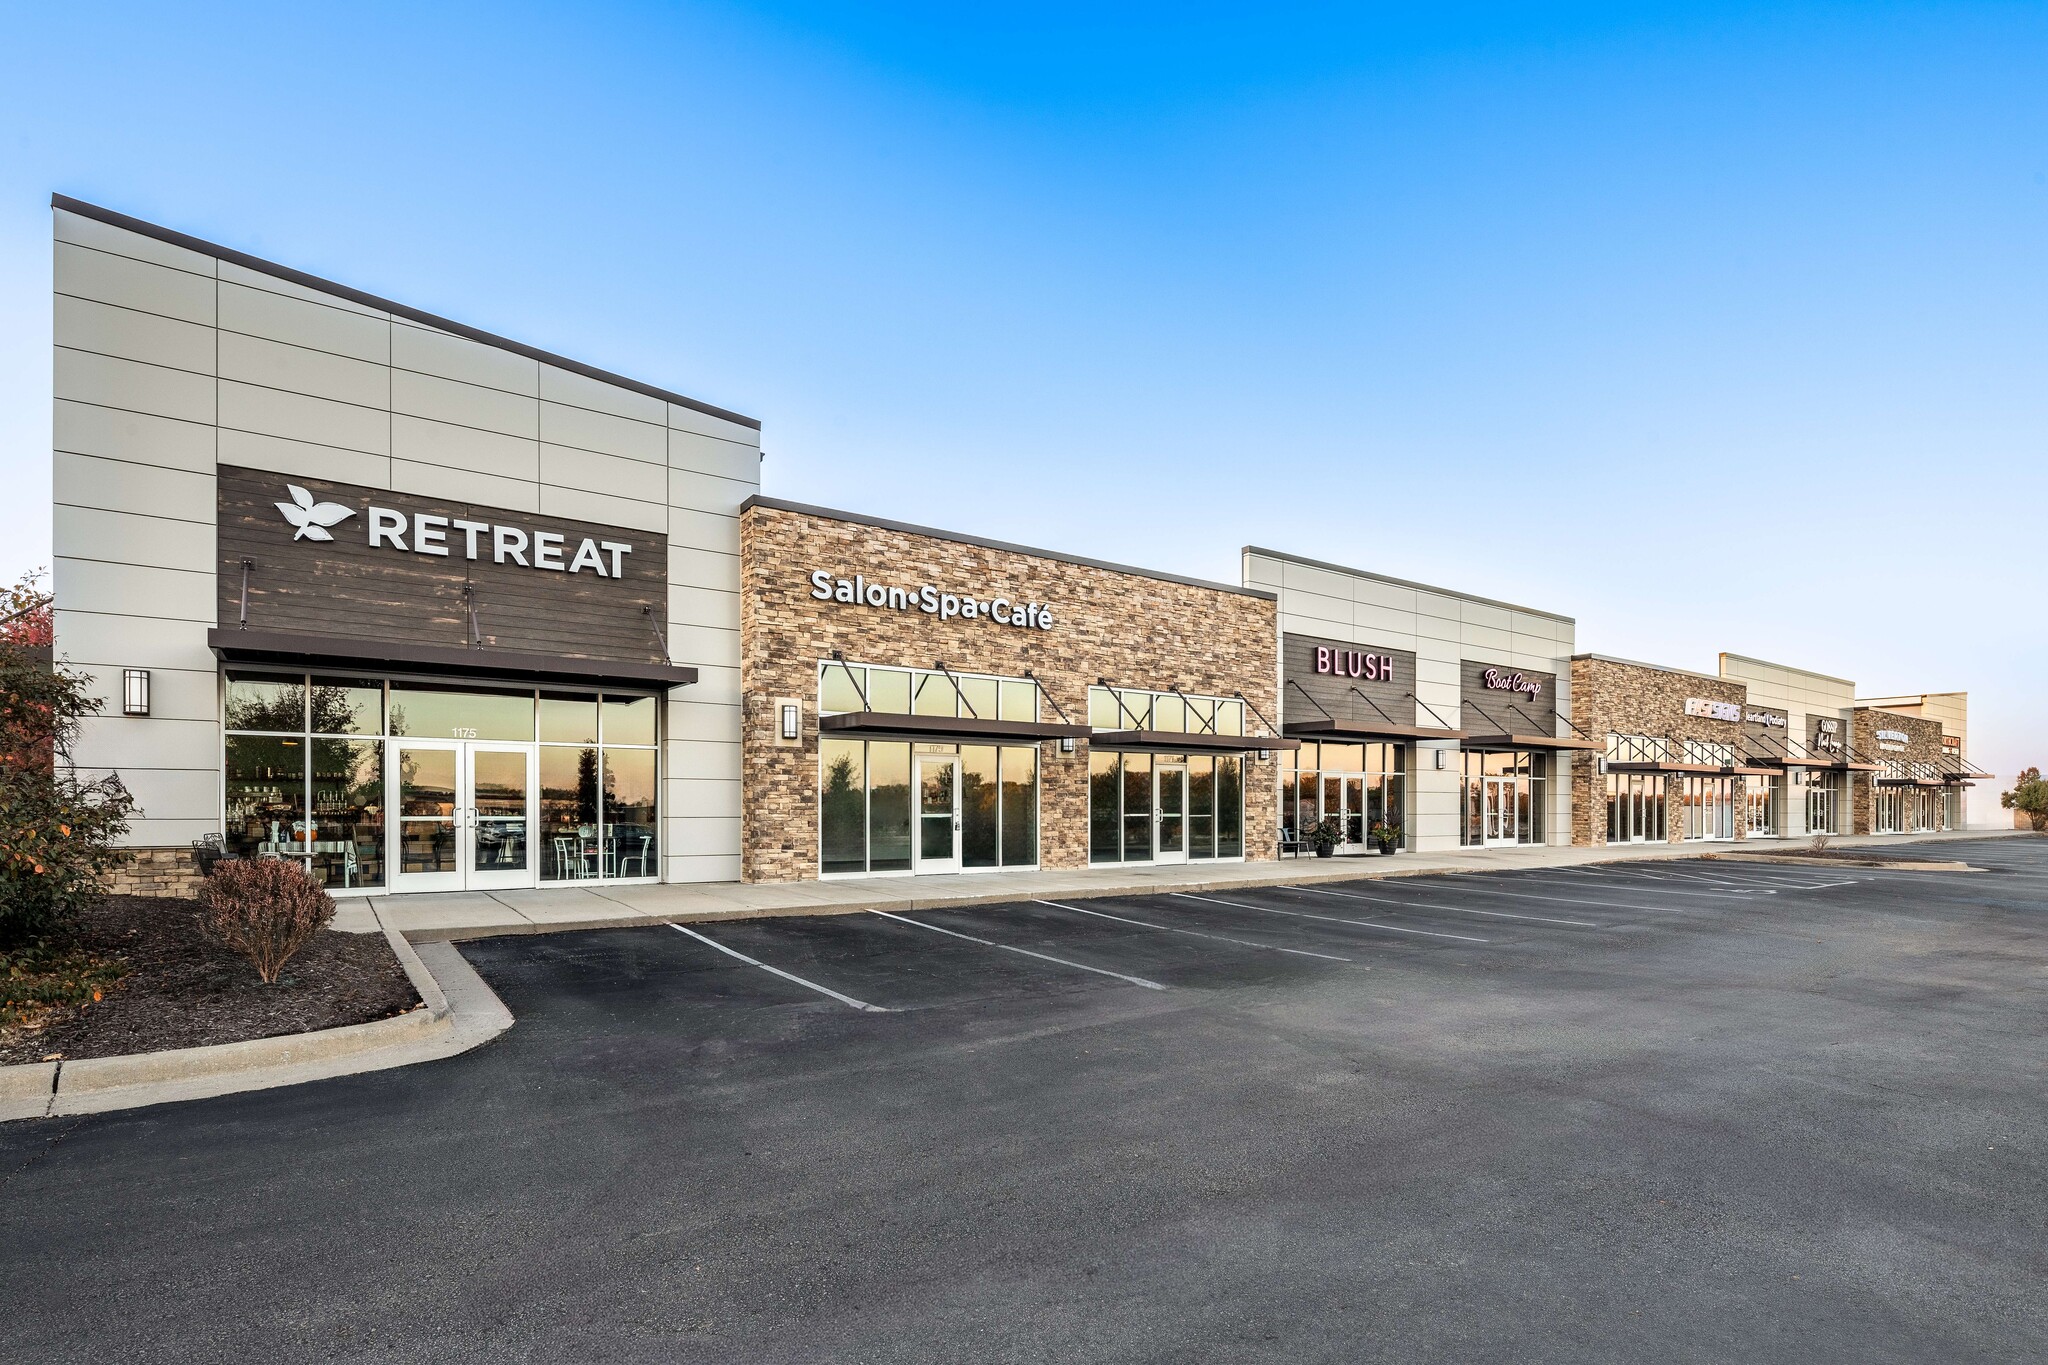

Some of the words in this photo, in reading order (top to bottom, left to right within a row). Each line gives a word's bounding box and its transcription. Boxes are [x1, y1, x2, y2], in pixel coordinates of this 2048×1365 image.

[367, 505, 632, 579] RETREAT
[1316, 646, 1393, 681] BLUSH
[1484, 668, 1512, 690] Boot
[1512, 672, 1542, 702] Camp
[1684, 697, 1742, 722] FASTSIGNS
[1769, 713, 1787, 728] Podiatry
[452, 727, 477, 738] 1175
